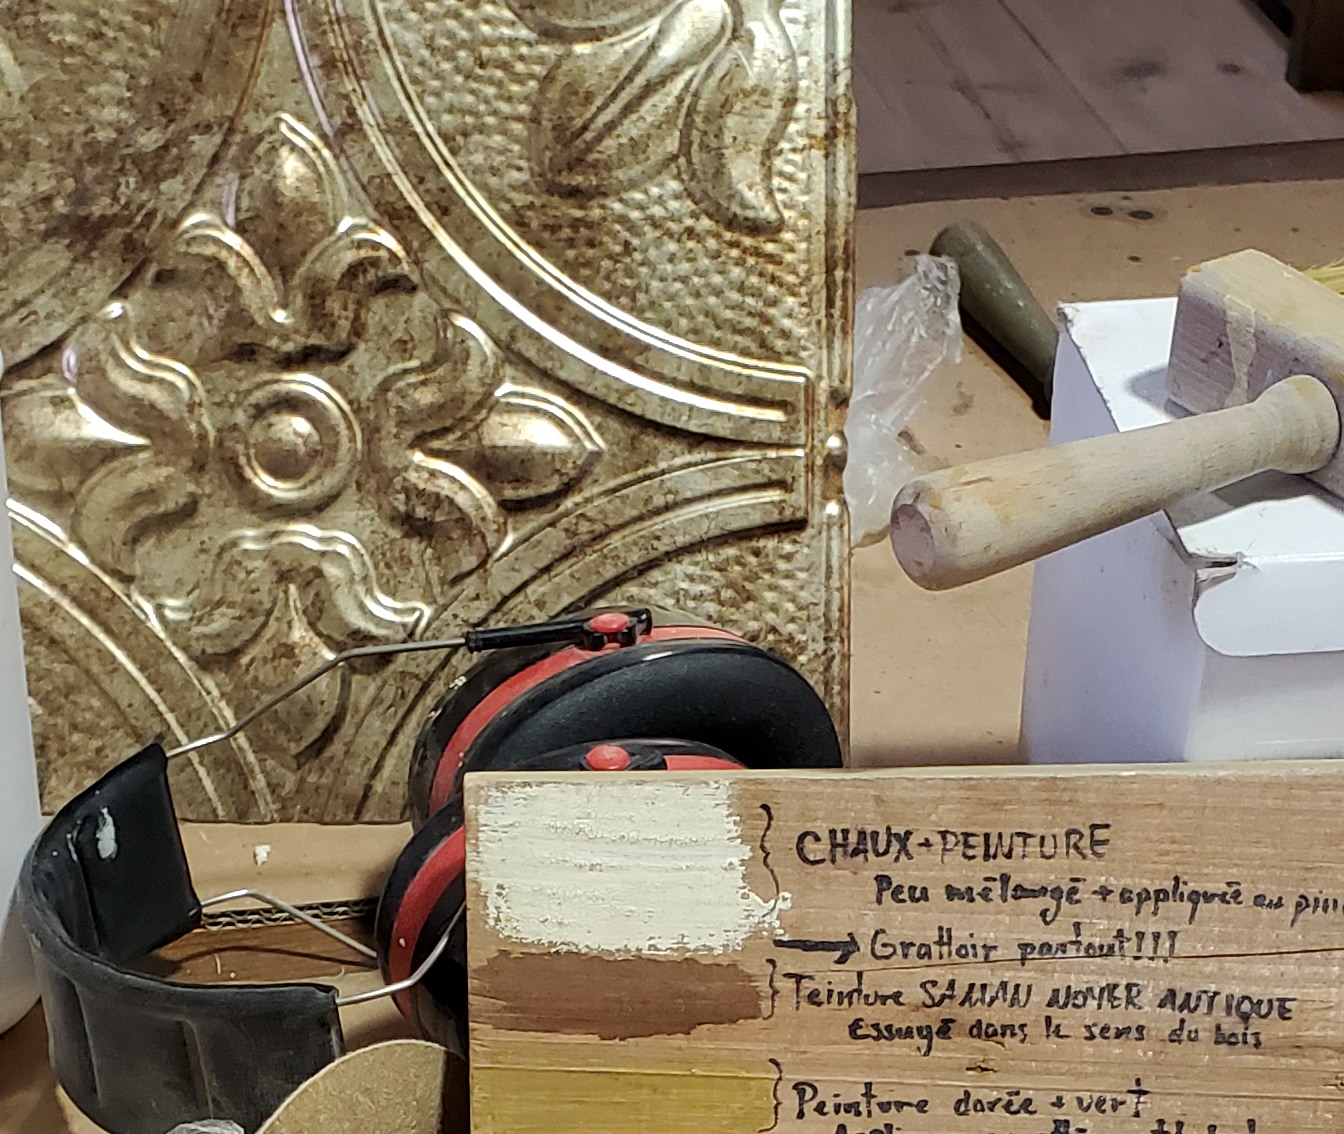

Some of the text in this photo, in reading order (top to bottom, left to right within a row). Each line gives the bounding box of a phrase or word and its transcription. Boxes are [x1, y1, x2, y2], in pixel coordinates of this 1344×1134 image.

[874, 874, 929, 905] Peu
[870, 926, 998, 960] Grattoir
[782, 970, 906, 1011] Teinture
[1044, 981, 1143, 1011] NOYER
[1157, 988, 1298, 1026] ANTIQUE
[969, 1018, 1028, 1043] dans
[1084, 1022, 1146, 1042] sens
[1168, 1018, 1199, 1045] du
[1214, 1023, 1263, 1049] bois
[791, 1081, 929, 1120] Peinture
[1076, 1078, 1151, 1118] vert
